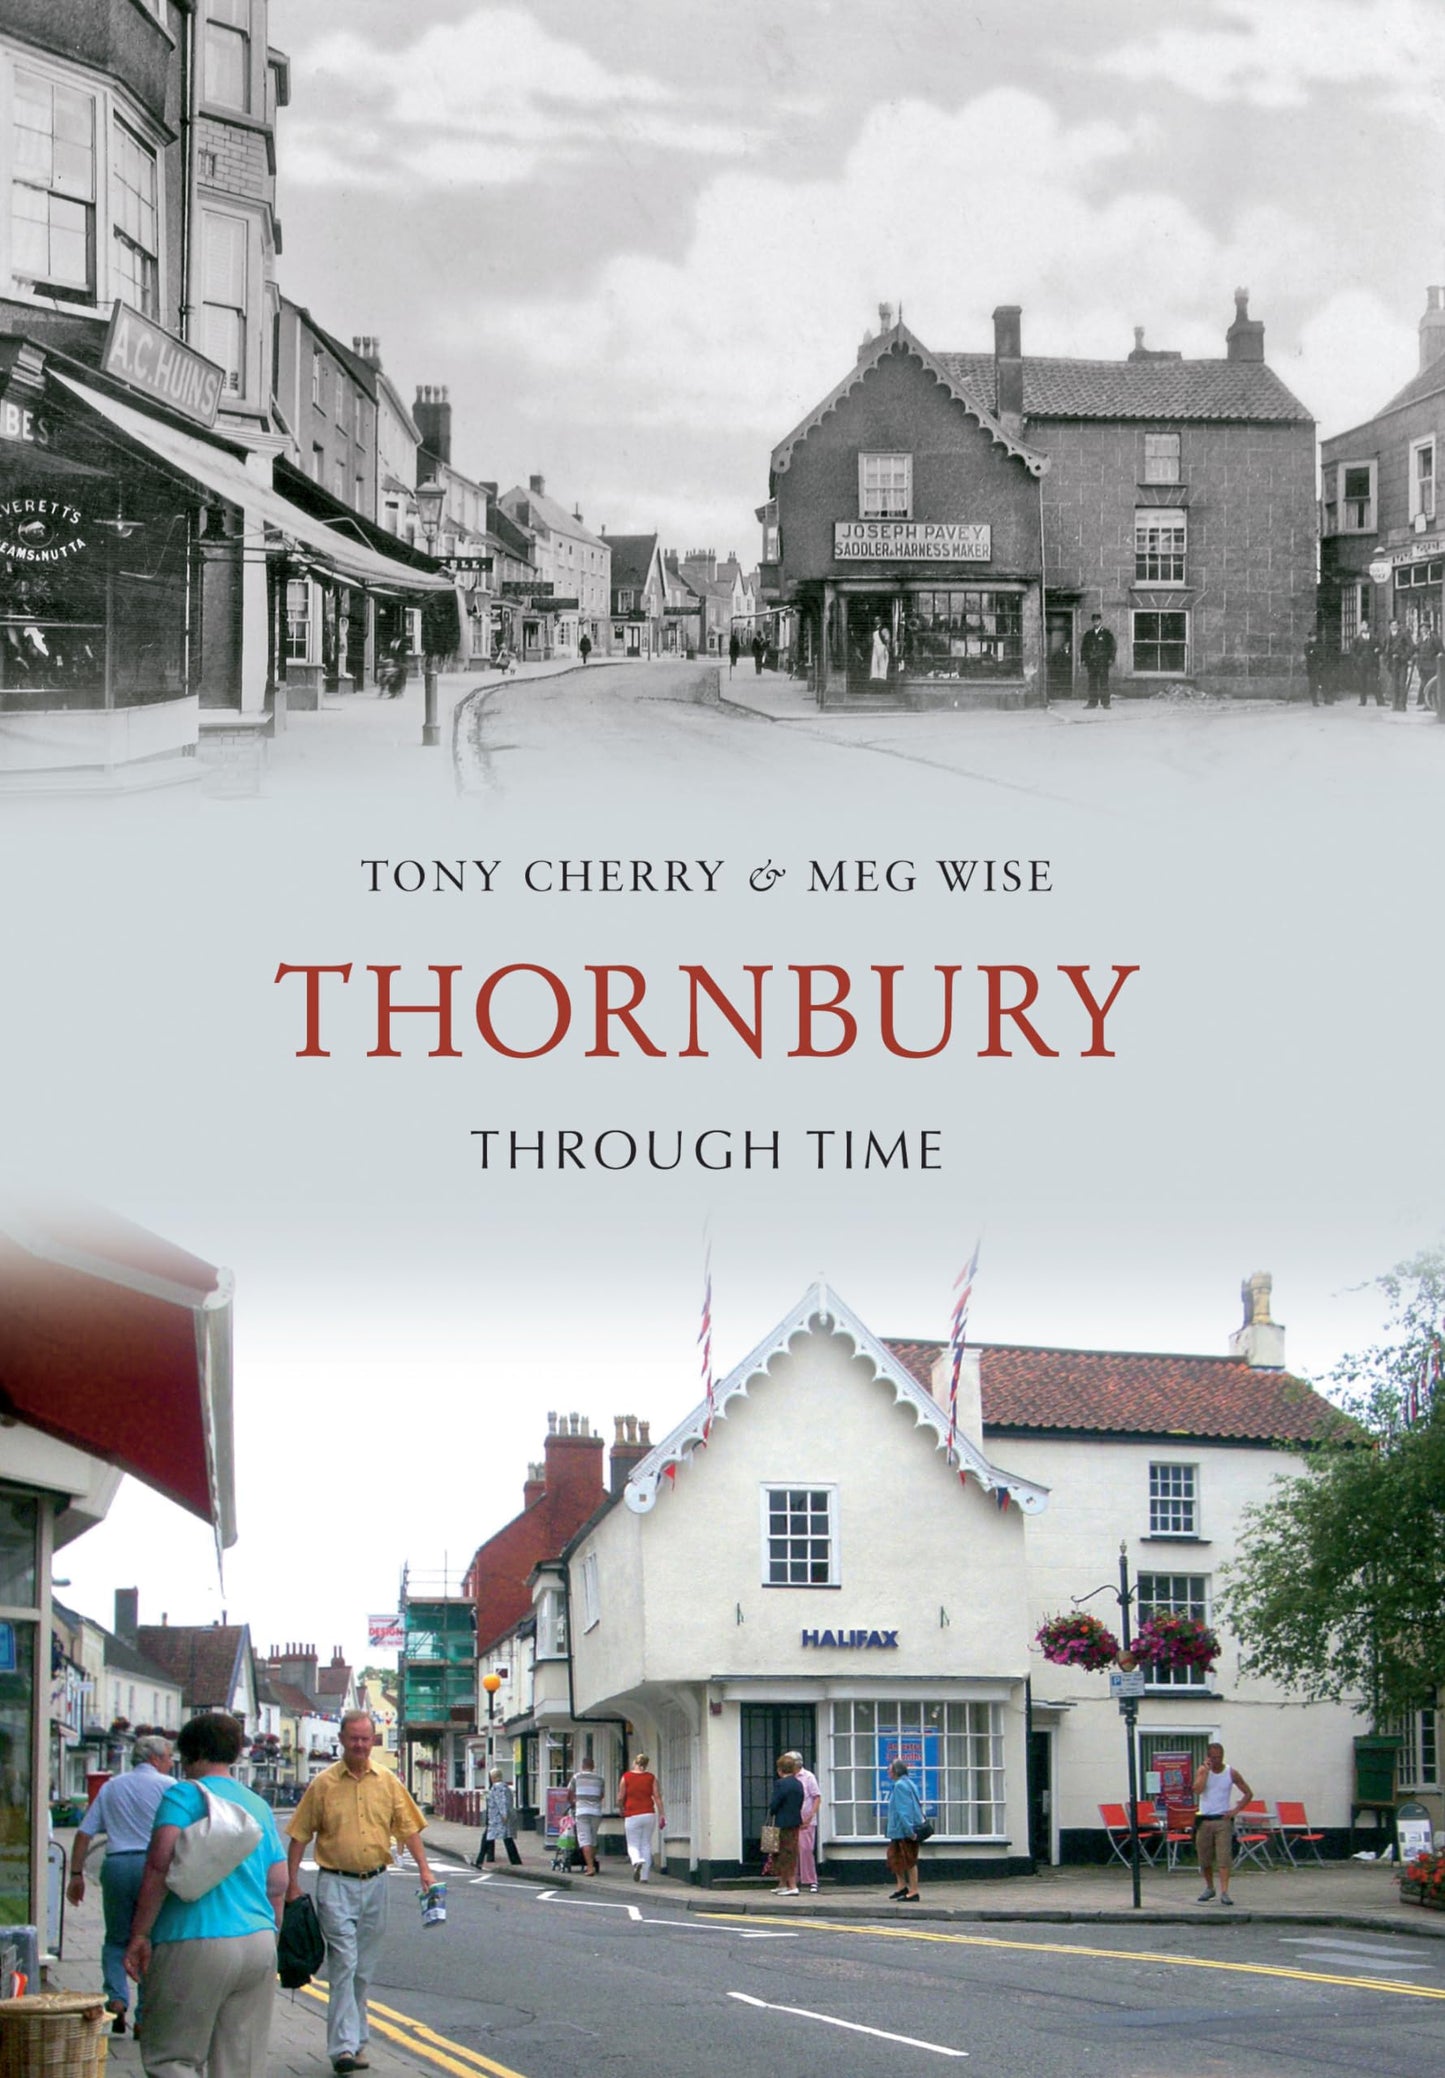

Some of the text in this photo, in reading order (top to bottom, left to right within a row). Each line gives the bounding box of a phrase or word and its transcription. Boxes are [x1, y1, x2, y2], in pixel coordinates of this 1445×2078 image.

[0, 499, 82, 525] VERETT'S
[842, 524, 917, 539] JOSEPH
[952, 542, 990, 558] MAKER
[801, 1628, 899, 1649] HALIFAX
